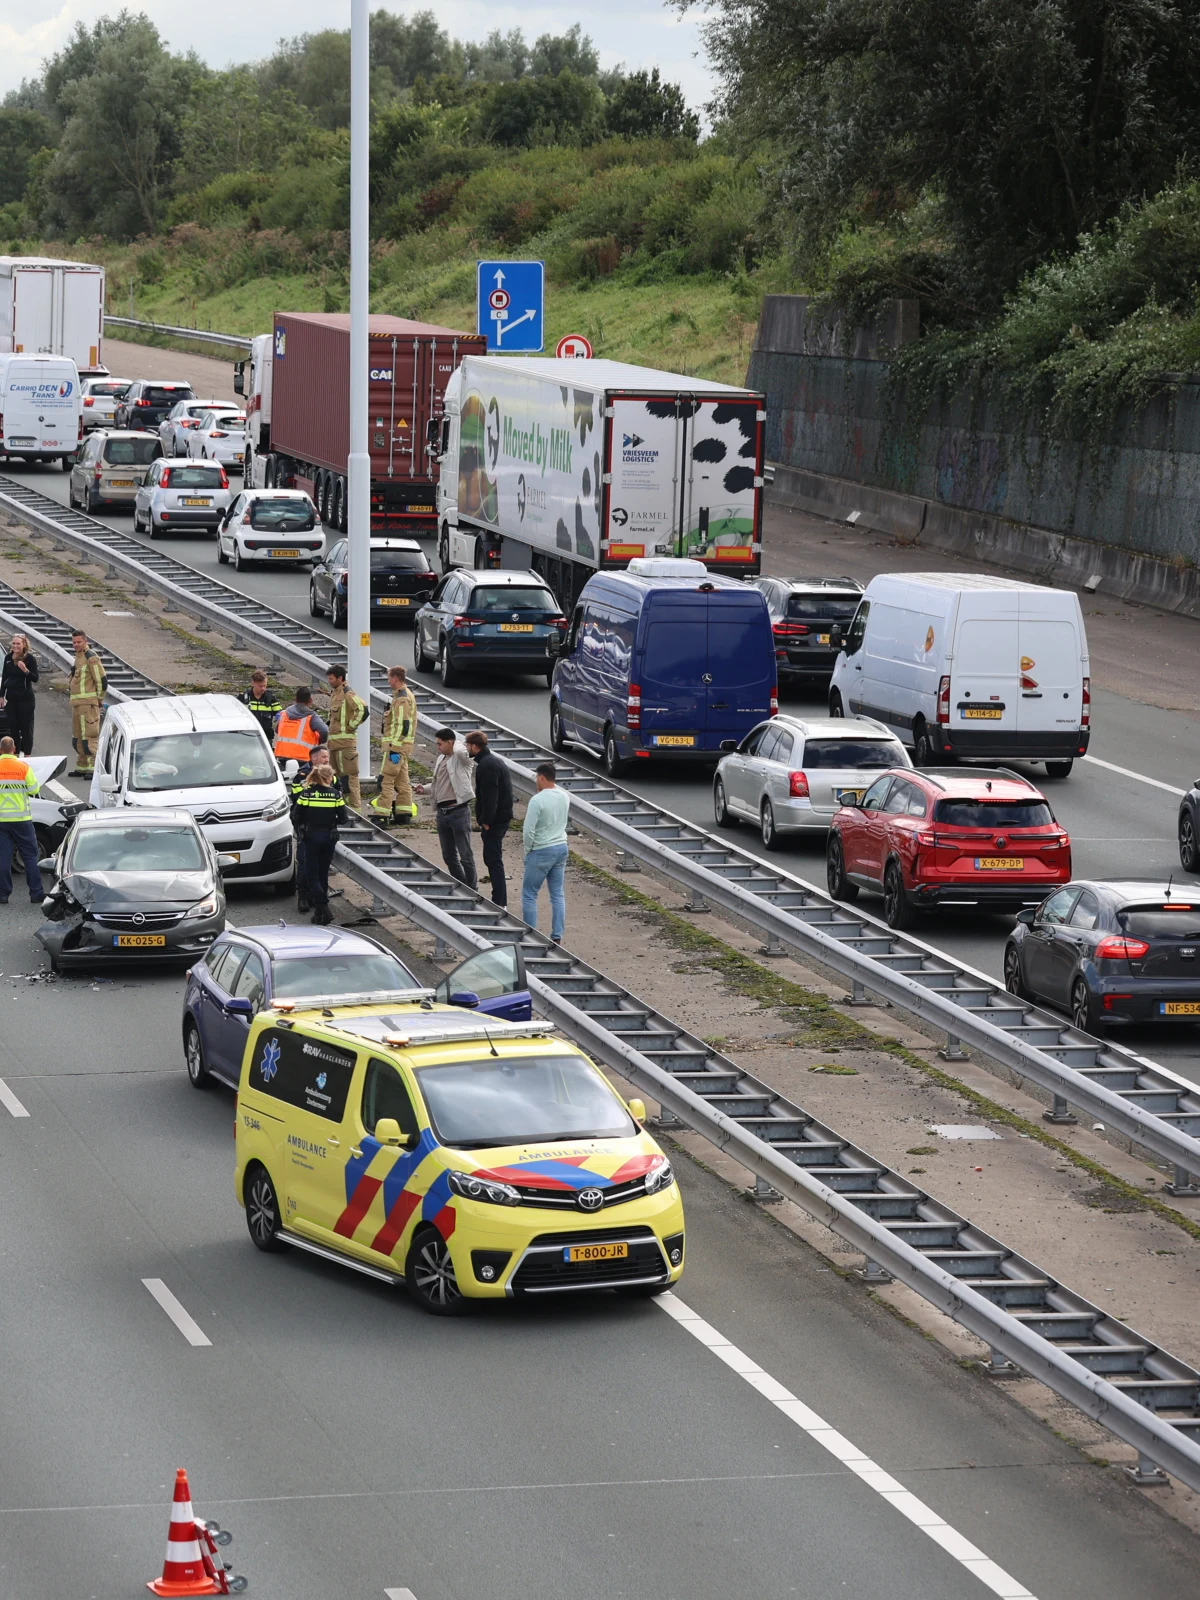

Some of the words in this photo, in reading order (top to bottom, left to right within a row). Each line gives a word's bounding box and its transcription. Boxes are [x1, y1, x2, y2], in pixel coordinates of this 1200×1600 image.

[370, 369, 392, 380] CAI
[502, 415, 535, 463] Moved
[536, 422, 548, 479] by
[549, 427, 573, 475] Milk
[622, 449, 659, 457] VRIESVEEM
[630, 511, 668, 520] FARMEL
[502, 624, 530, 632] J-753-TT
[968, 710, 997, 718] V-114-SJ
[659, 736, 691, 745] VG-163-L
[981, 859, 1022, 868] X-679-DP
[120, 936, 163, 945] KK-025-G
[287, 1133, 327, 1158] AMBULANCE
[518, 1148, 614, 1161] AMBULANCE
[573, 1246, 625, 1260] T-800-JR
